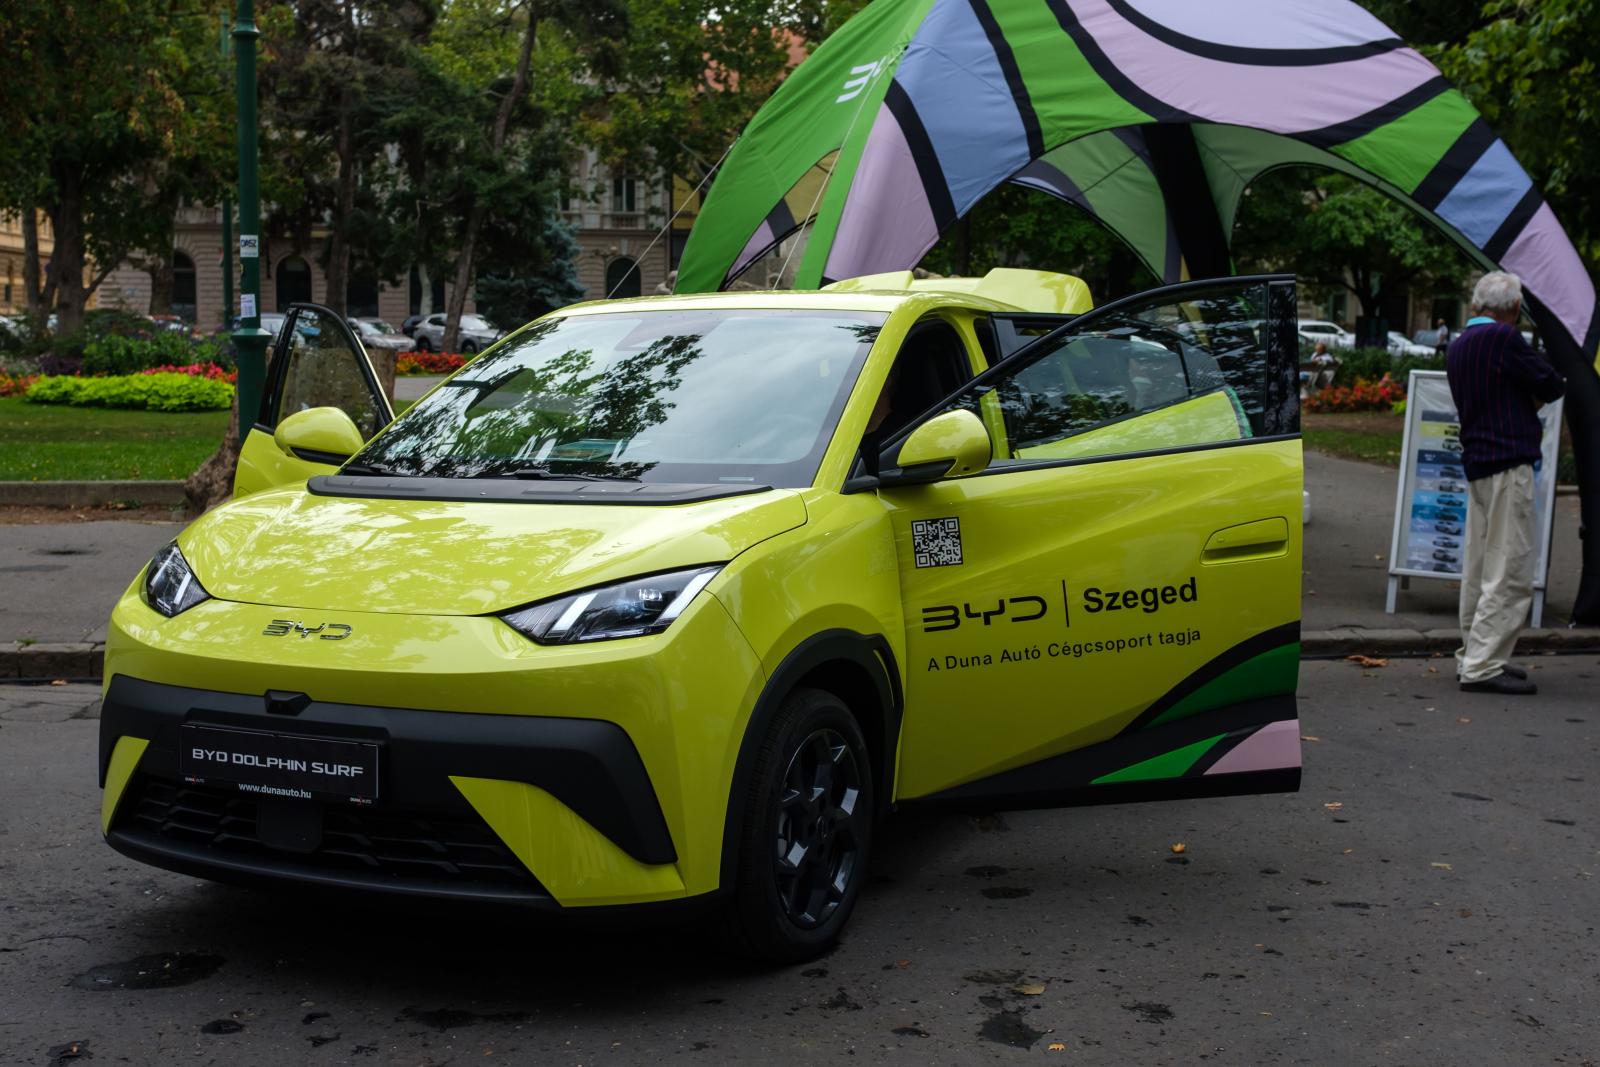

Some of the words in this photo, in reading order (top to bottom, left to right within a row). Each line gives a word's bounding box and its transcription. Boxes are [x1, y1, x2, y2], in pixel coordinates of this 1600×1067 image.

[922, 595, 1047, 632] BYD
[1083, 577, 1198, 613] Szeged
[262, 619, 352, 641] BYD
[927, 657, 940, 672] A
[945, 654, 993, 670] Duna
[1000, 645, 1041, 663] Autó
[1047, 633, 1153, 658] Cégcsoport
[1158, 628, 1201, 646] tagja
[192, 748, 228, 762] BYD
[232, 753, 307, 772] DOLPHIN
[311, 762, 364, 777] SURF
[238, 783, 312, 799] www.dunaauto.hu
